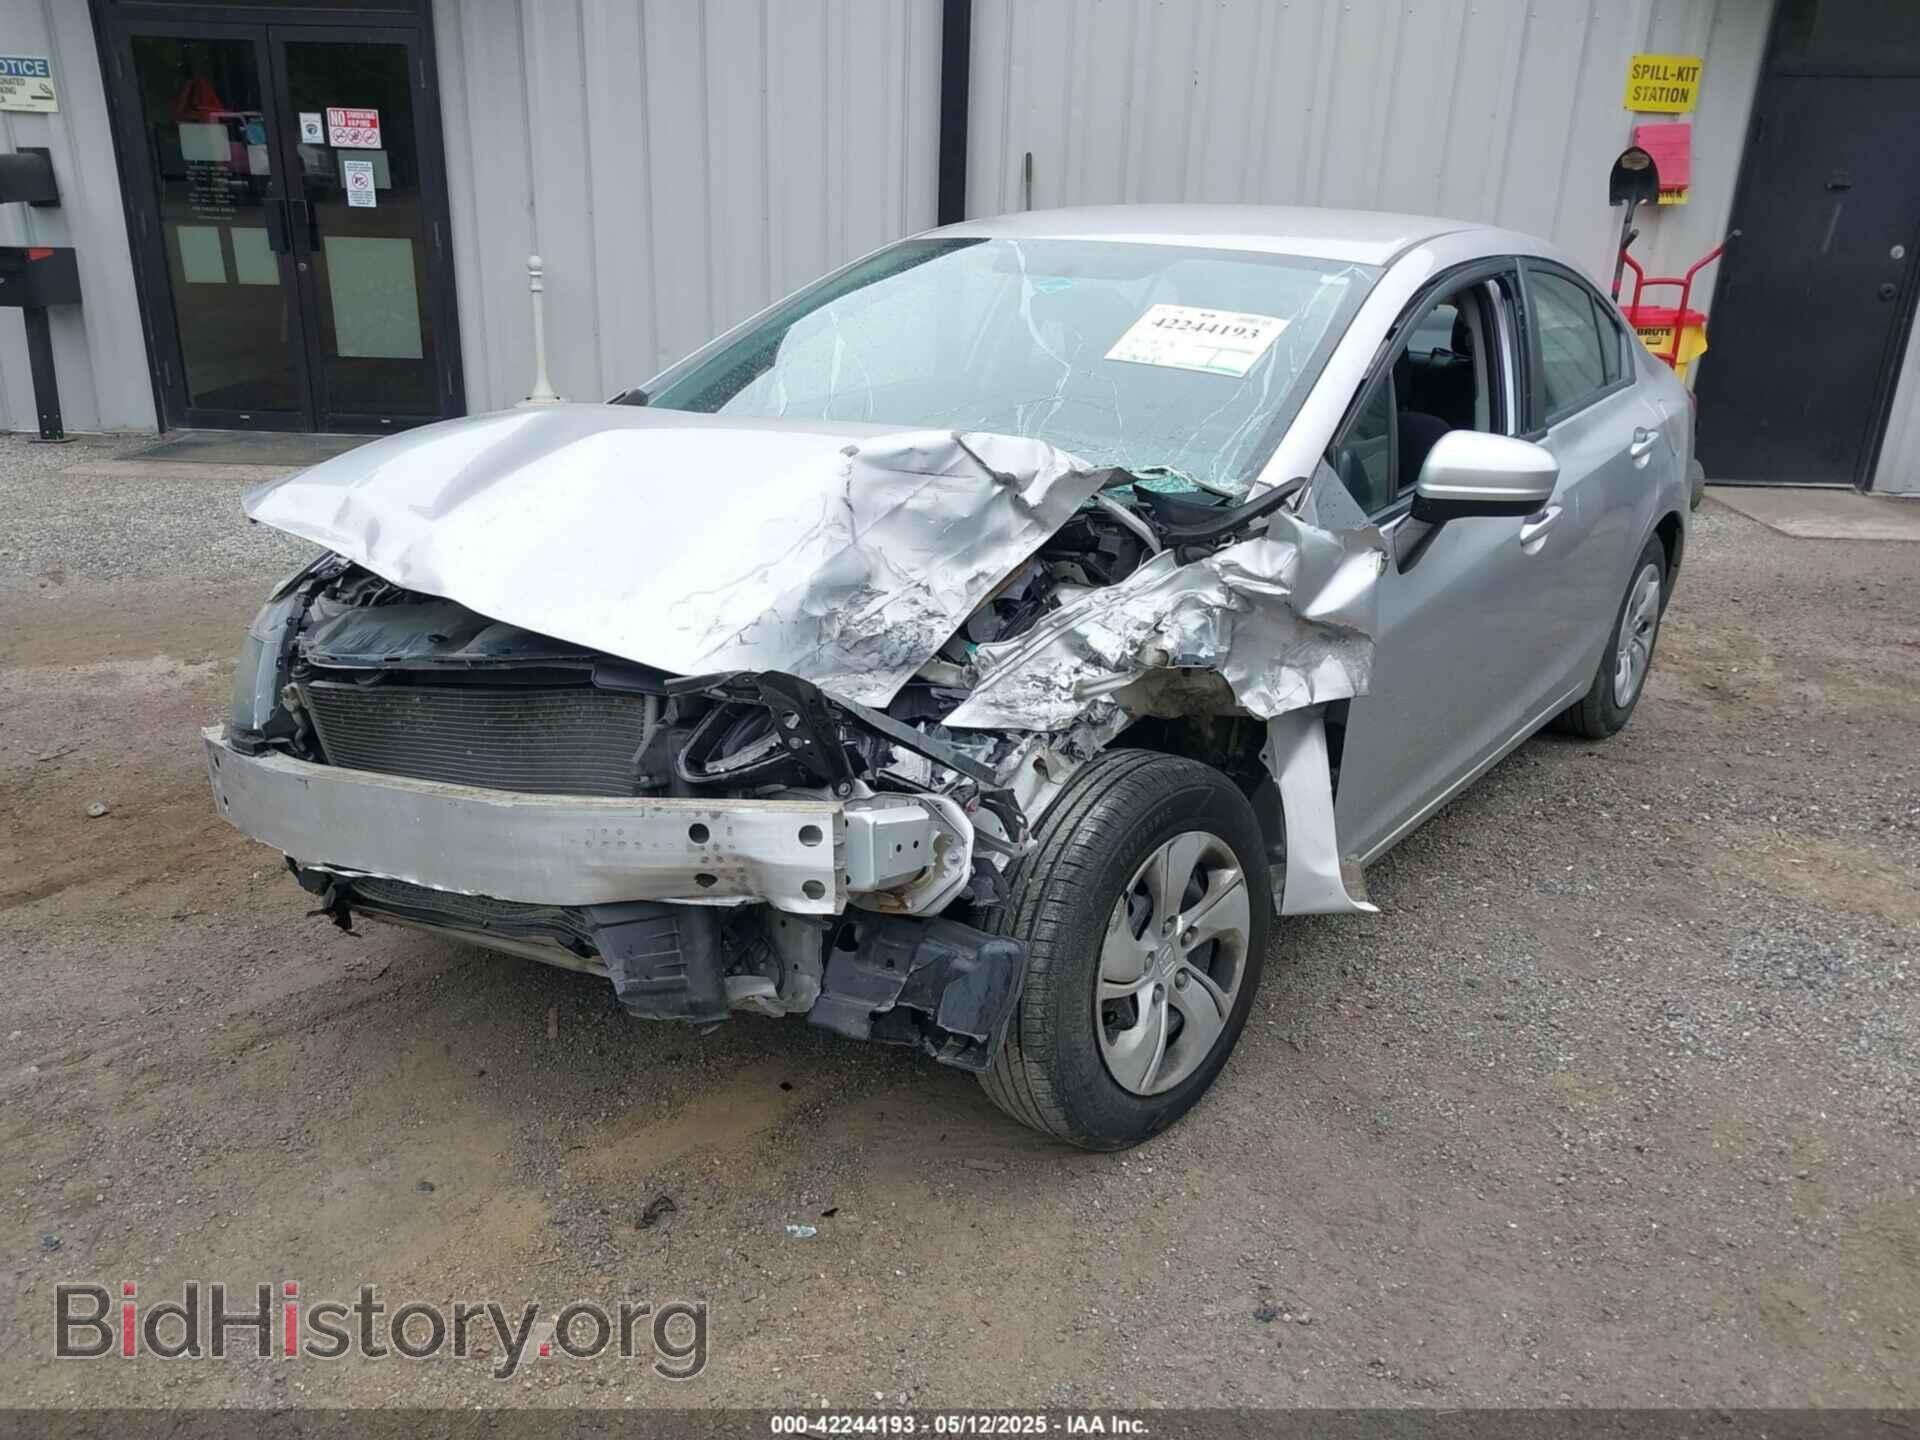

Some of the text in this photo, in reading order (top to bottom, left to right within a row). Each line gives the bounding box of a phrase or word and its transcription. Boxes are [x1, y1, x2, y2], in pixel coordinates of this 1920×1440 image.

[1632, 63, 1699, 82] SPILL-KIT
[1633, 86, 1690, 104] STATION
[330, 110, 346, 127] NO
[1151, 318, 1260, 339] 42244193
[1637, 327, 1672, 337] BRUTE
